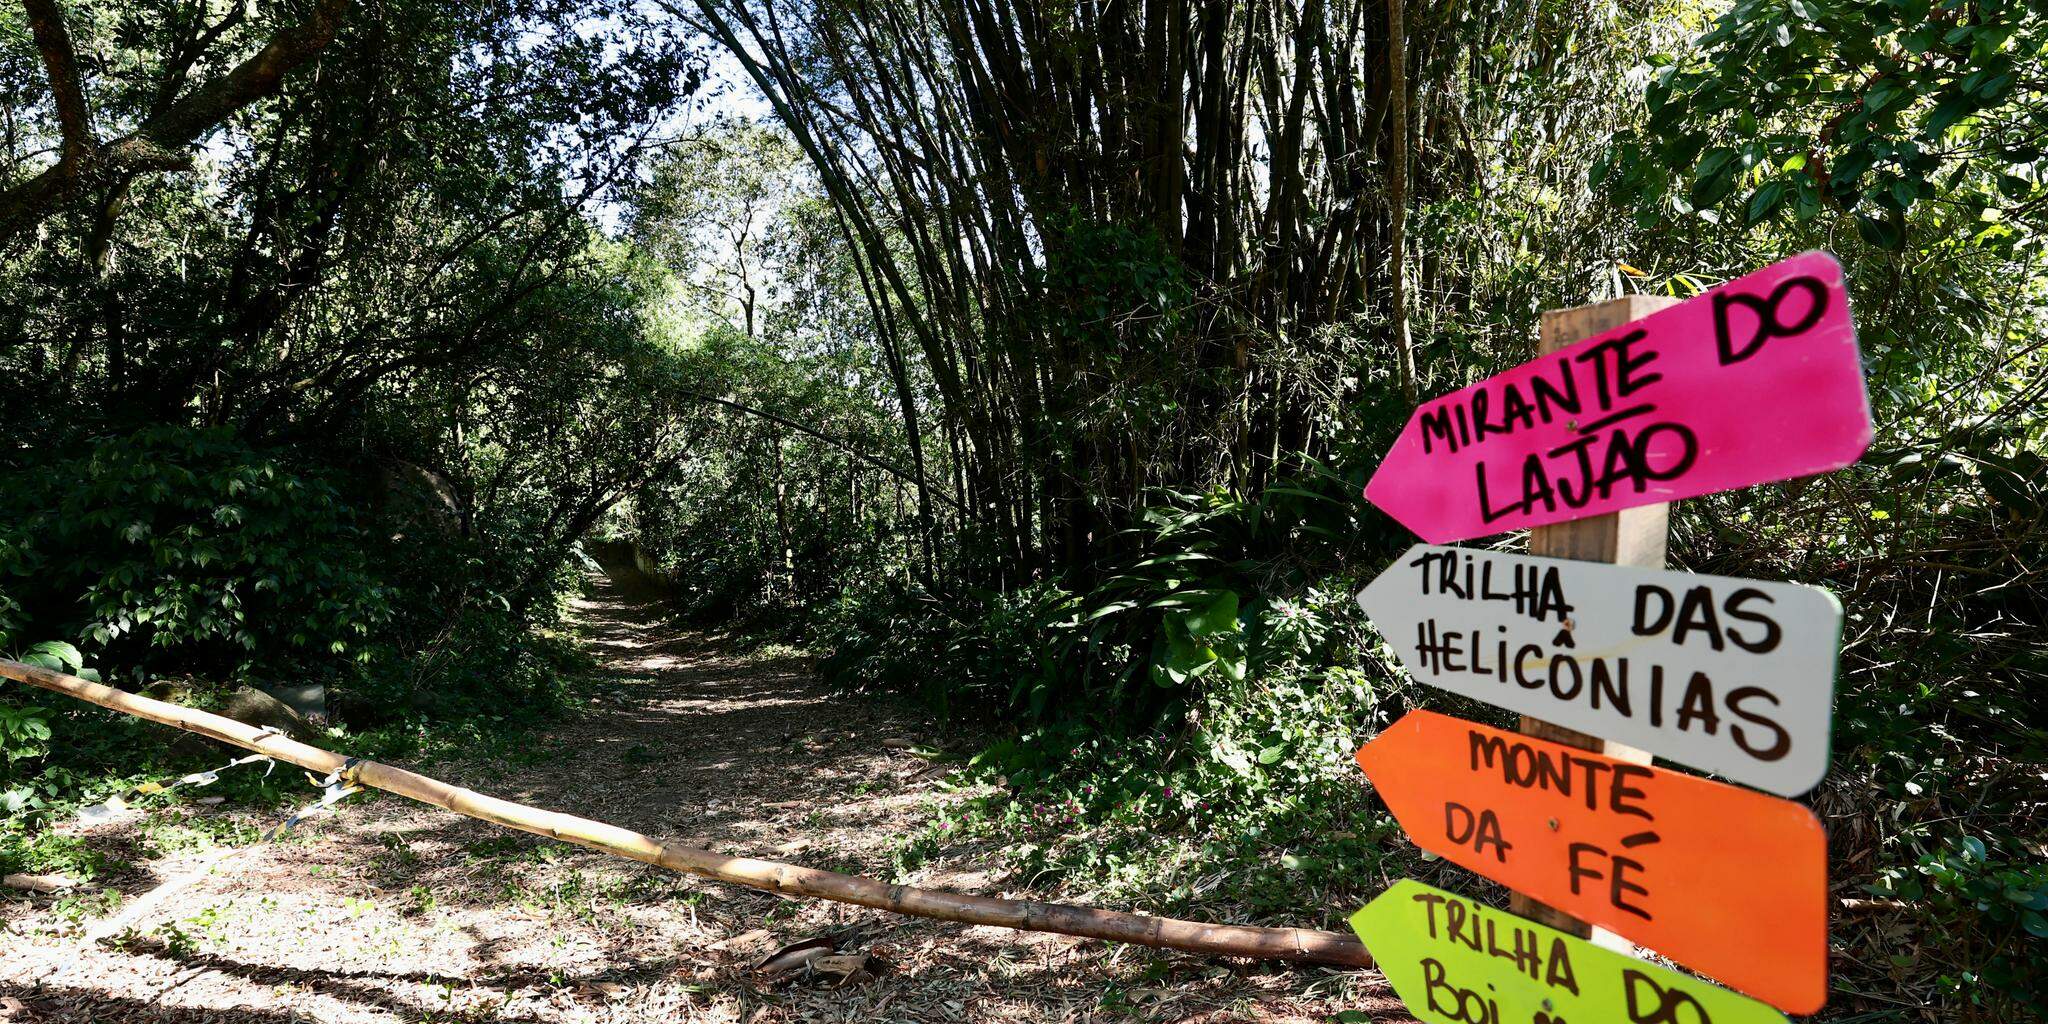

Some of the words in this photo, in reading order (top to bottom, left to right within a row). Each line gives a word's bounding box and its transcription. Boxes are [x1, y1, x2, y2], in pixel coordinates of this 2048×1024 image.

[1420, 330, 1663, 454] MIRANTE
[1713, 276, 1829, 366] DO
[1631, 583, 1782, 655] DAS
[1468, 730, 1656, 822] MONTE
[1444, 802, 1512, 863] DA
[1568, 831, 1661, 921] FÉ
[1622, 969, 1713, 1024] DO
